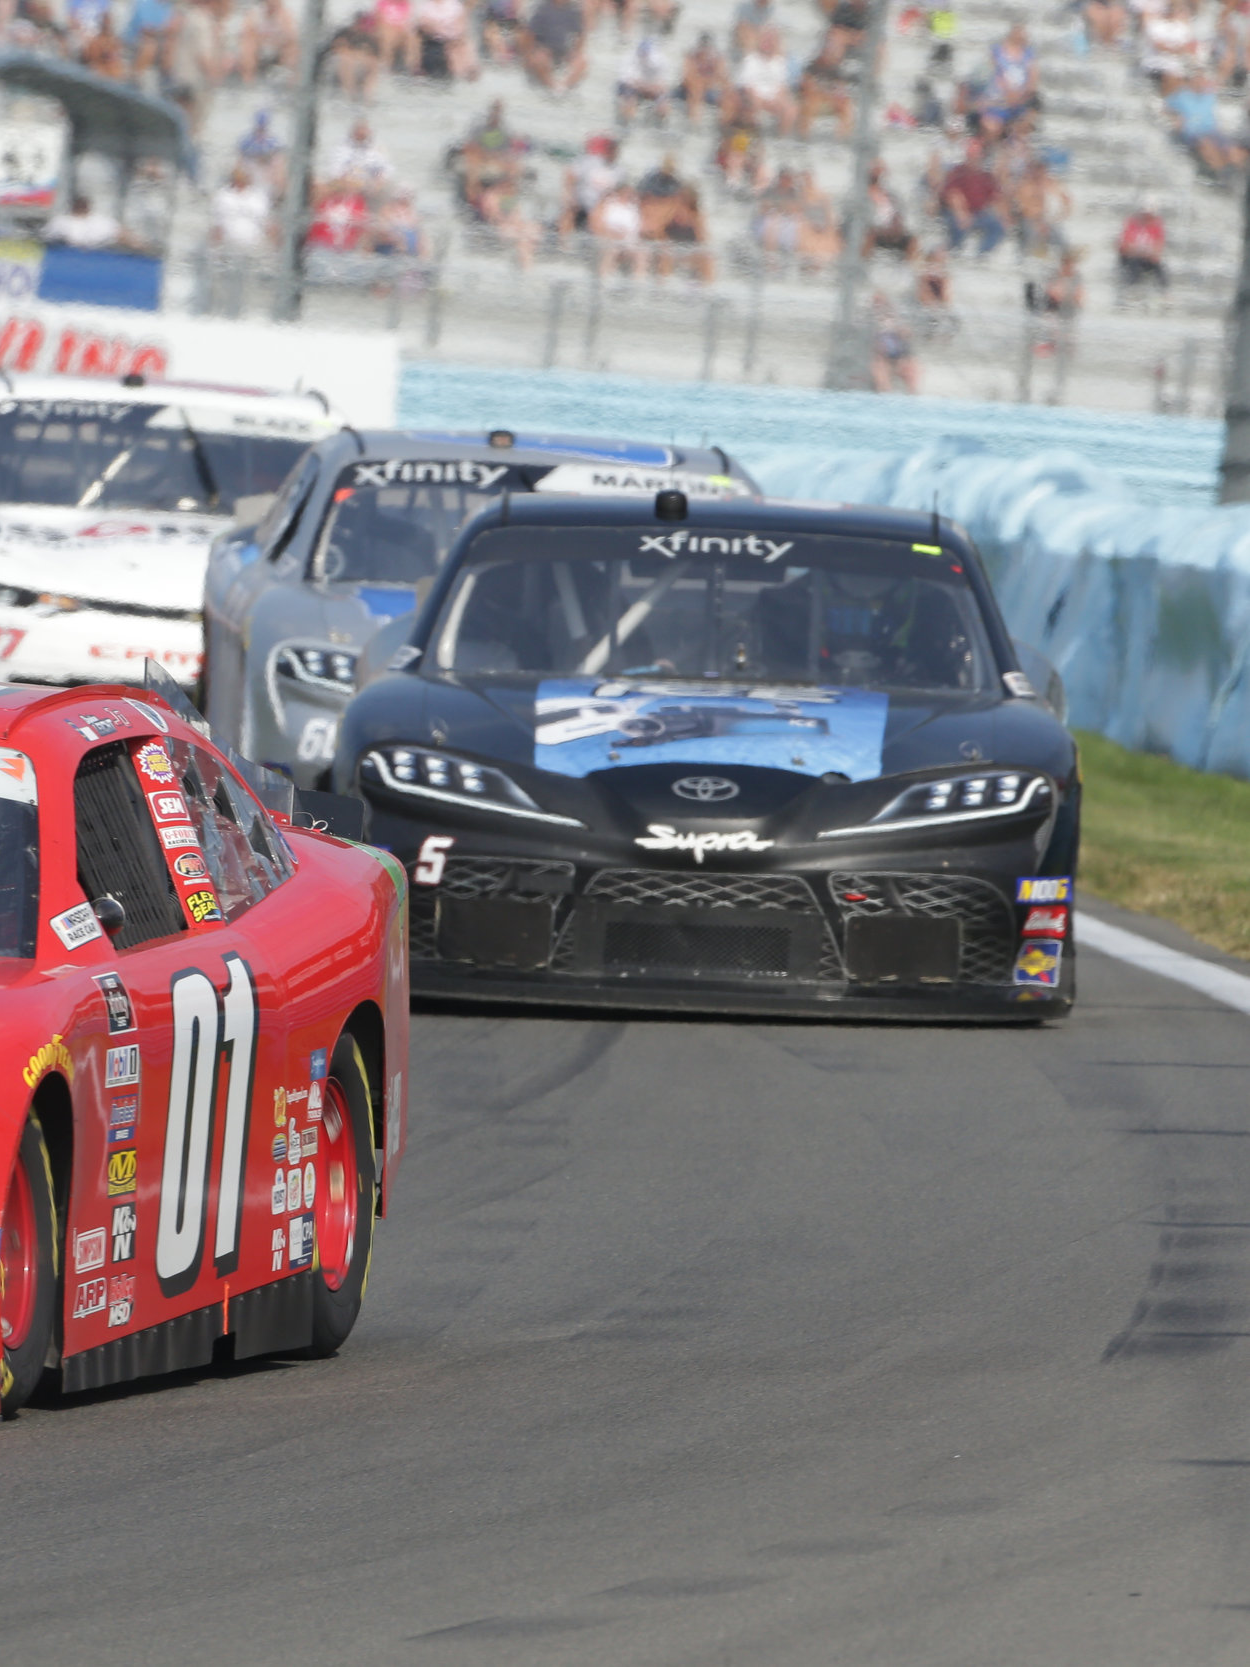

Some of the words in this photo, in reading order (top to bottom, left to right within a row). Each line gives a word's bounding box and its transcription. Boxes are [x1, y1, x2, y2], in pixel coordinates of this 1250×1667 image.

[354, 459, 510, 488] xfinity
[637, 530, 795, 564] xfinity
[414, 834, 456, 884] 5
[634, 823, 776, 865] Supra
[186, 890, 215, 912] FLEX
[66, 927, 86, 942] RACE
[155, 953, 259, 1290] 01
